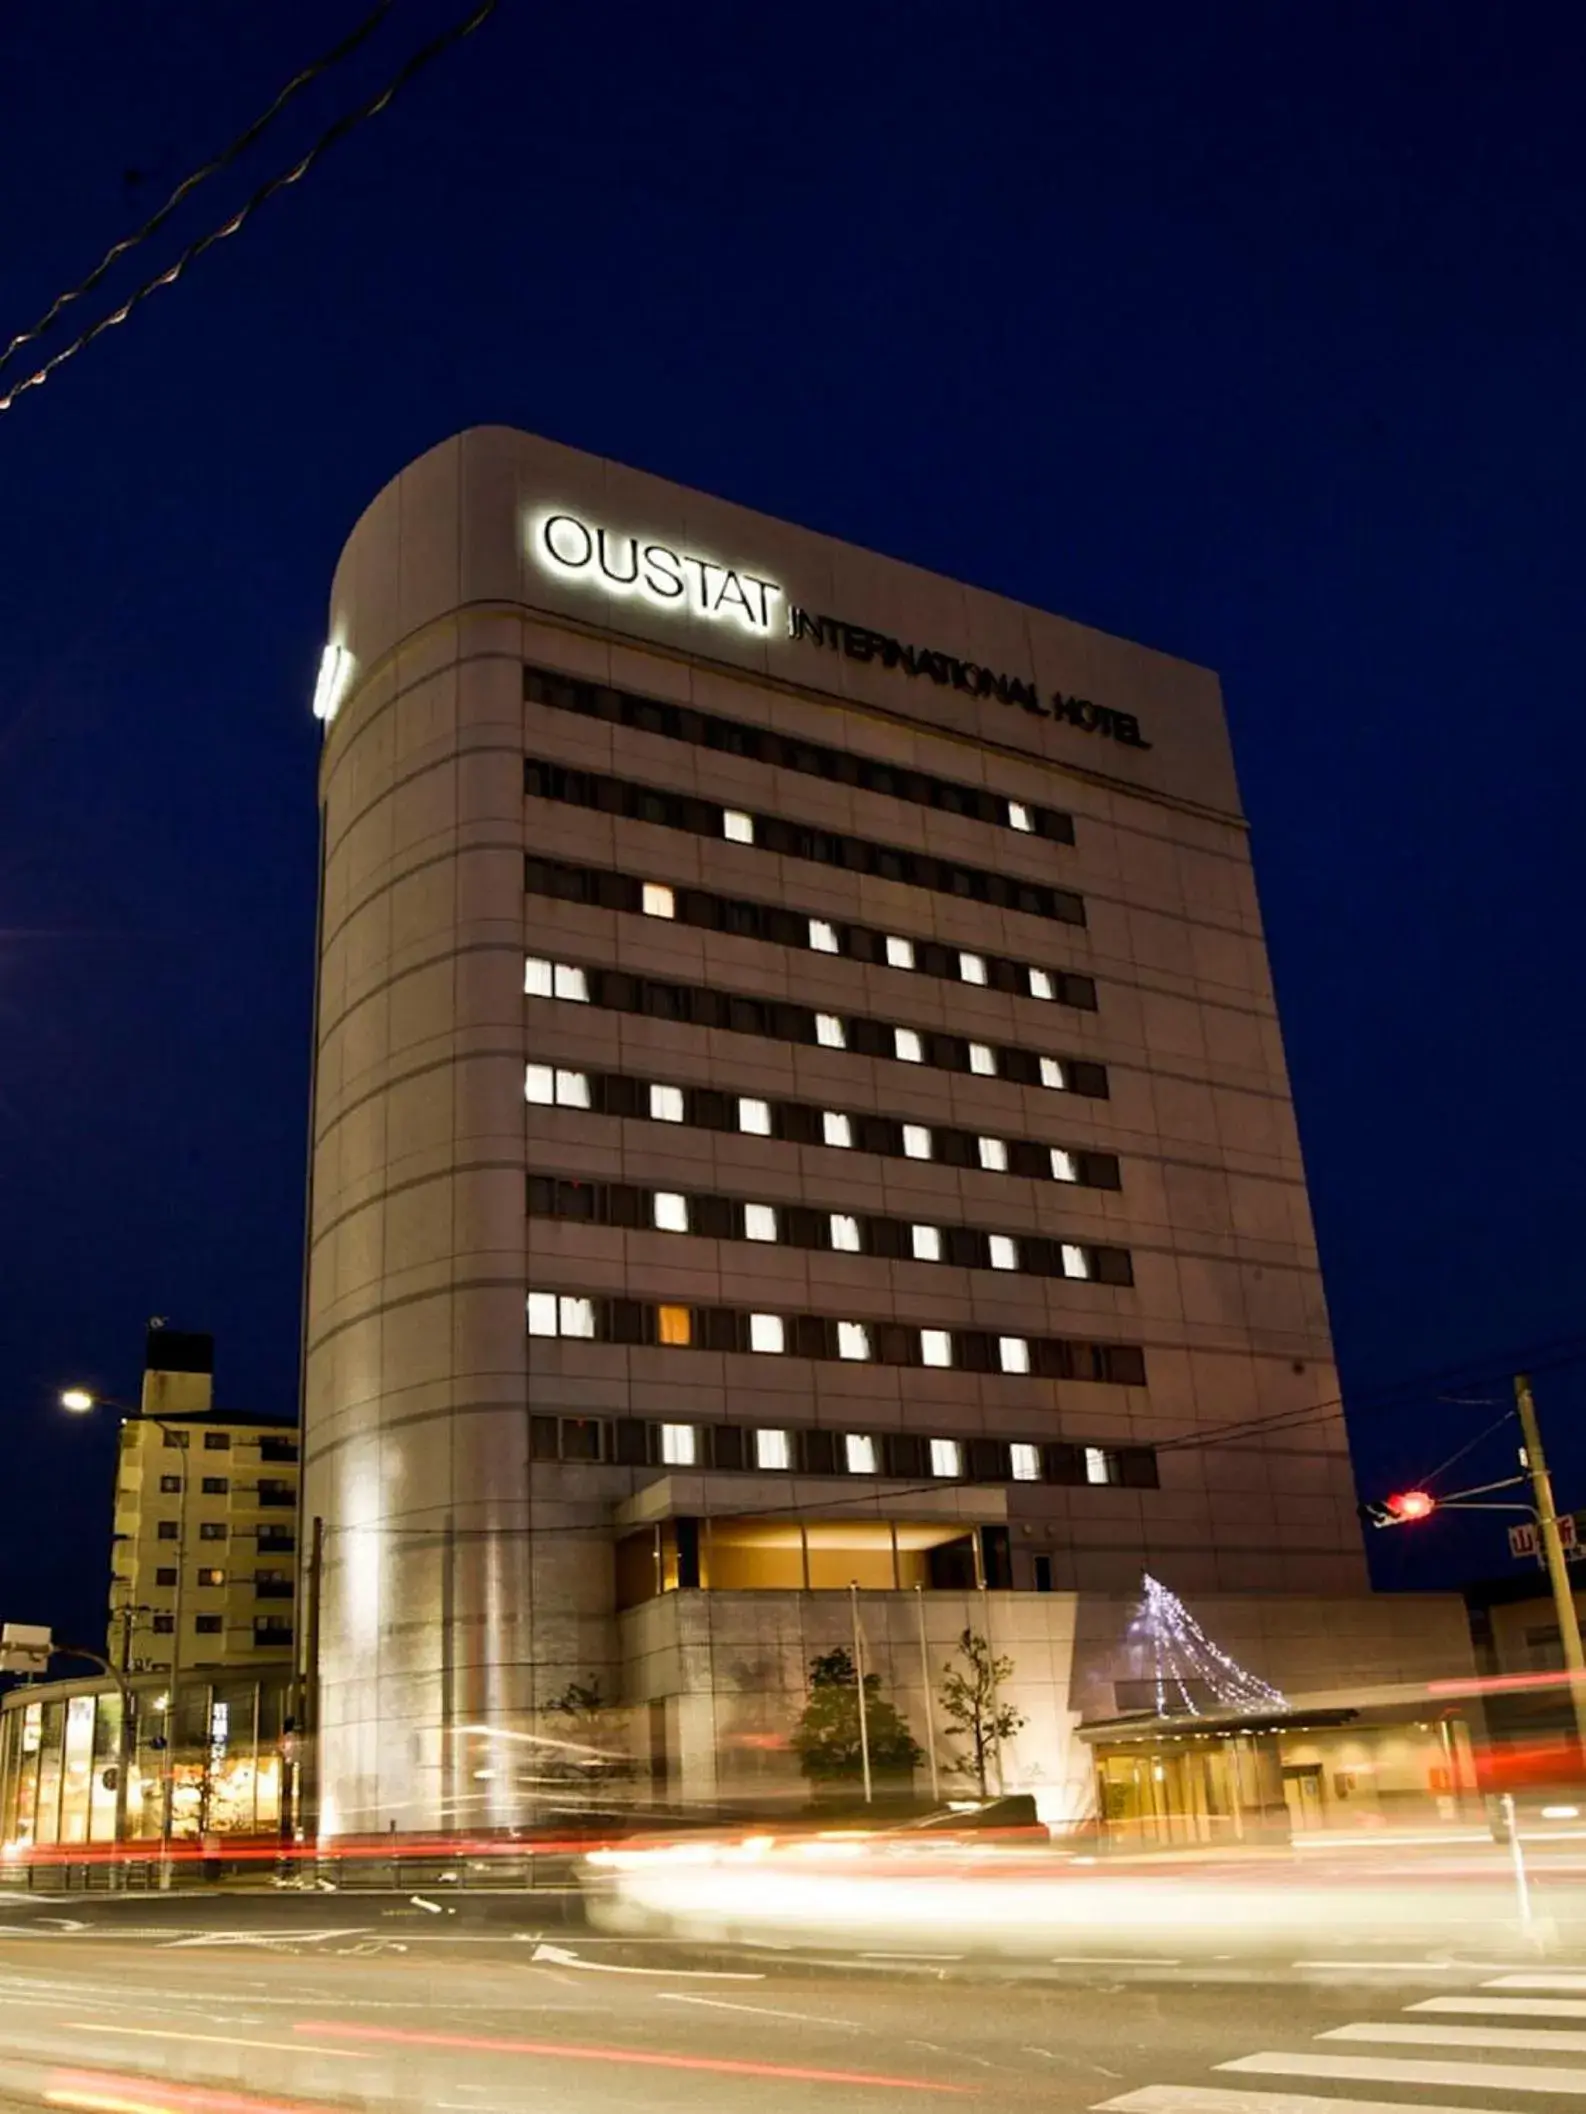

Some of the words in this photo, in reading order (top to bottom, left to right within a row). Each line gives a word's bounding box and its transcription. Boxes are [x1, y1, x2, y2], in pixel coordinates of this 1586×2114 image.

[544, 515, 781, 626] OUSTAT
[788, 604, 1051, 718] INTERNATIONAL
[1053, 690, 1153, 750] HOTEL
